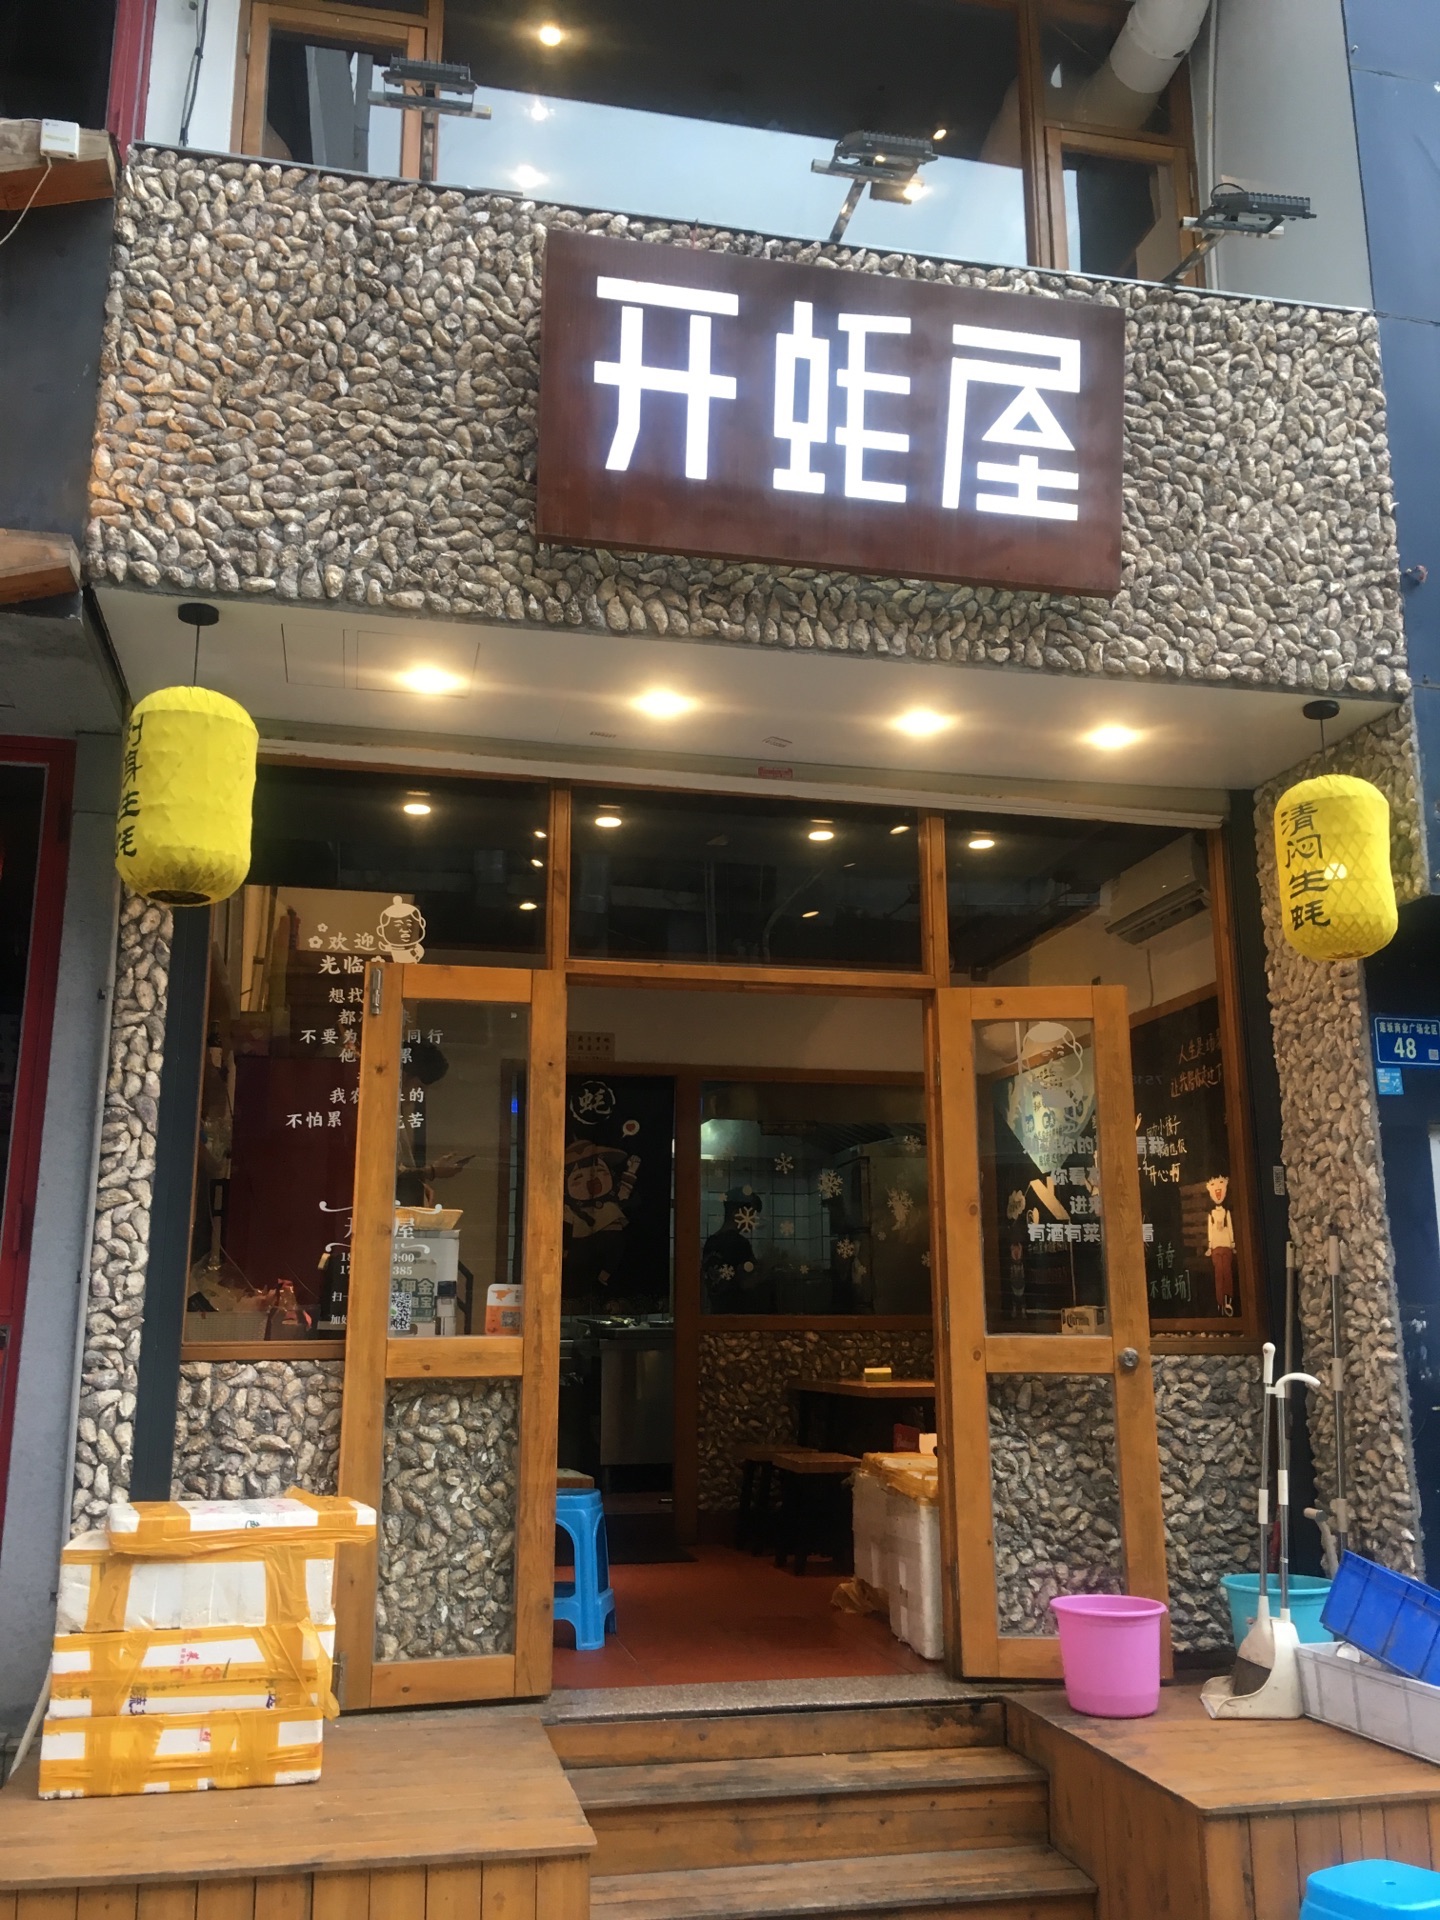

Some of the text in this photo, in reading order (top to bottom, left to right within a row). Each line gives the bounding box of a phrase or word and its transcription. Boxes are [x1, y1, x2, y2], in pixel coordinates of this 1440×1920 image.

[593, 276, 1081, 522] 开蚝屋
[1280, 802, 1331, 931] 清闷生蚝
[328, 932, 377, 951] 欢迎
[318, 955, 364, 974] 光临
[407, 1029, 443, 1045] 同行
[1394, 1037, 1417, 1059] 48
[285, 1111, 342, 1129] 不怕累
[1028, 1223, 1101, 1243] 有酒有菜
